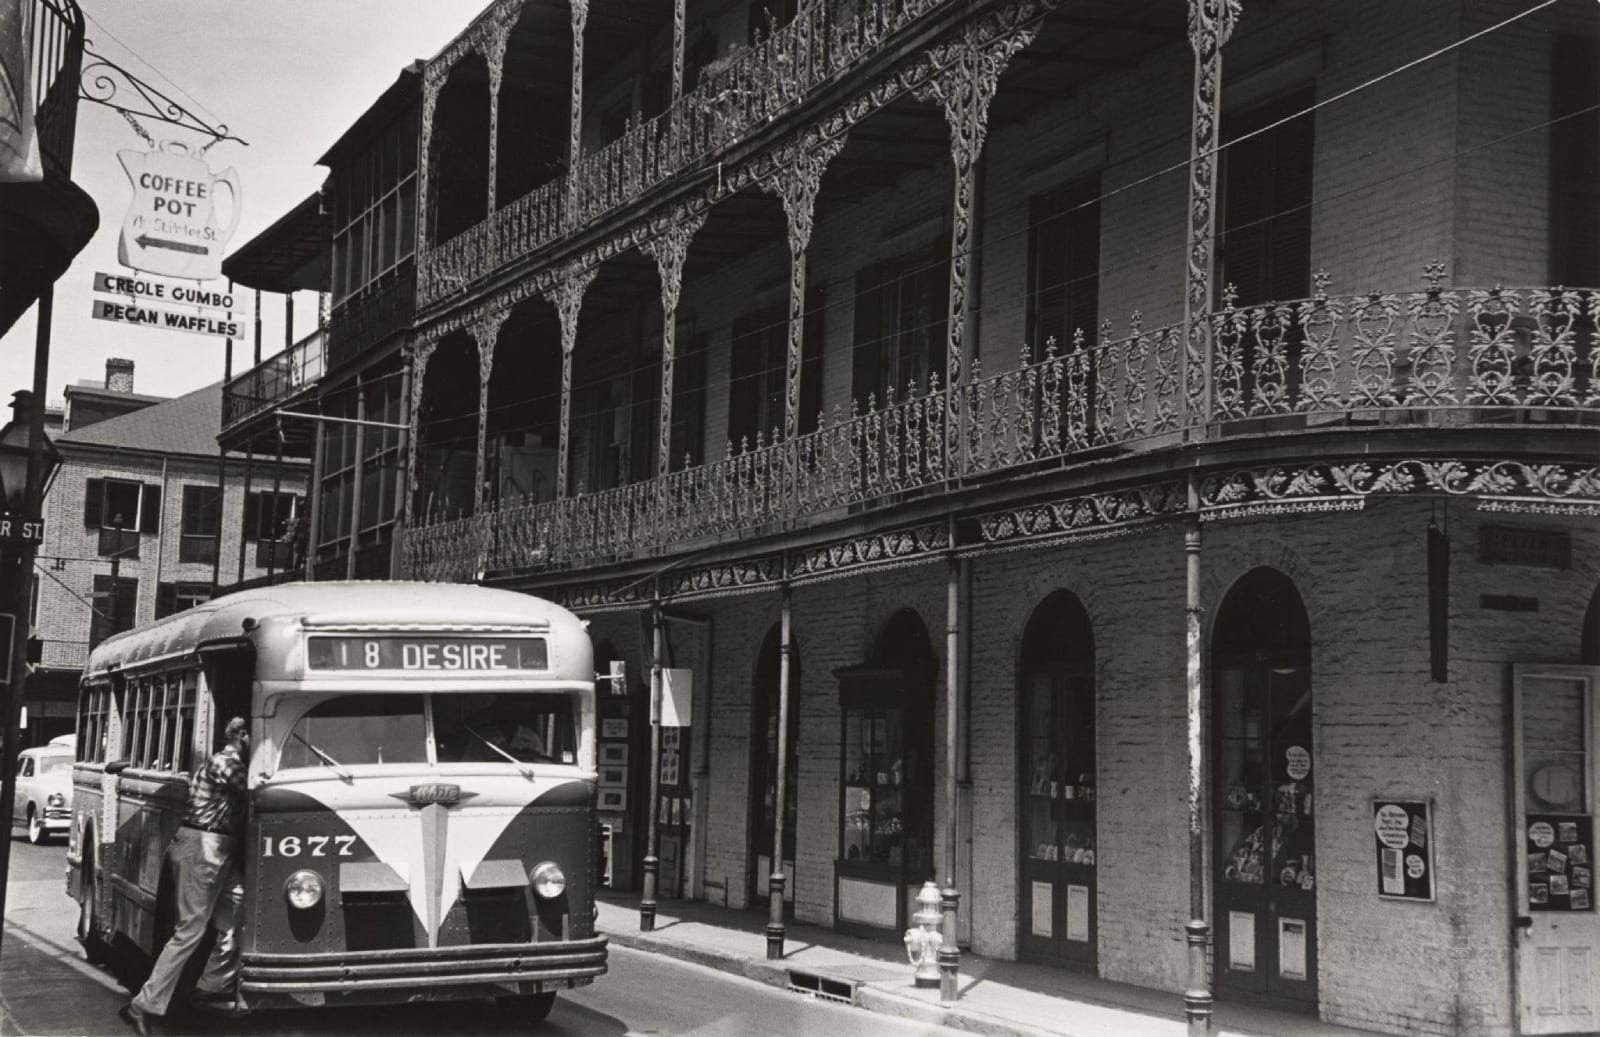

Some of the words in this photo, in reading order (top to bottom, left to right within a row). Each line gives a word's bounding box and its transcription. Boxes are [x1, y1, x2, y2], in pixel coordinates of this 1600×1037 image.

[139, 172, 207, 199] COFFEE
[153, 196, 197, 217] POT
[104, 276, 164, 297] CREOLE
[172, 287, 233, 308] GUMBO
[103, 303, 158, 324] PECAN
[164, 313, 237, 336] WAFFLES
[403, 644, 508, 669] DESIRE
[262, 834, 357, 857] 1677
